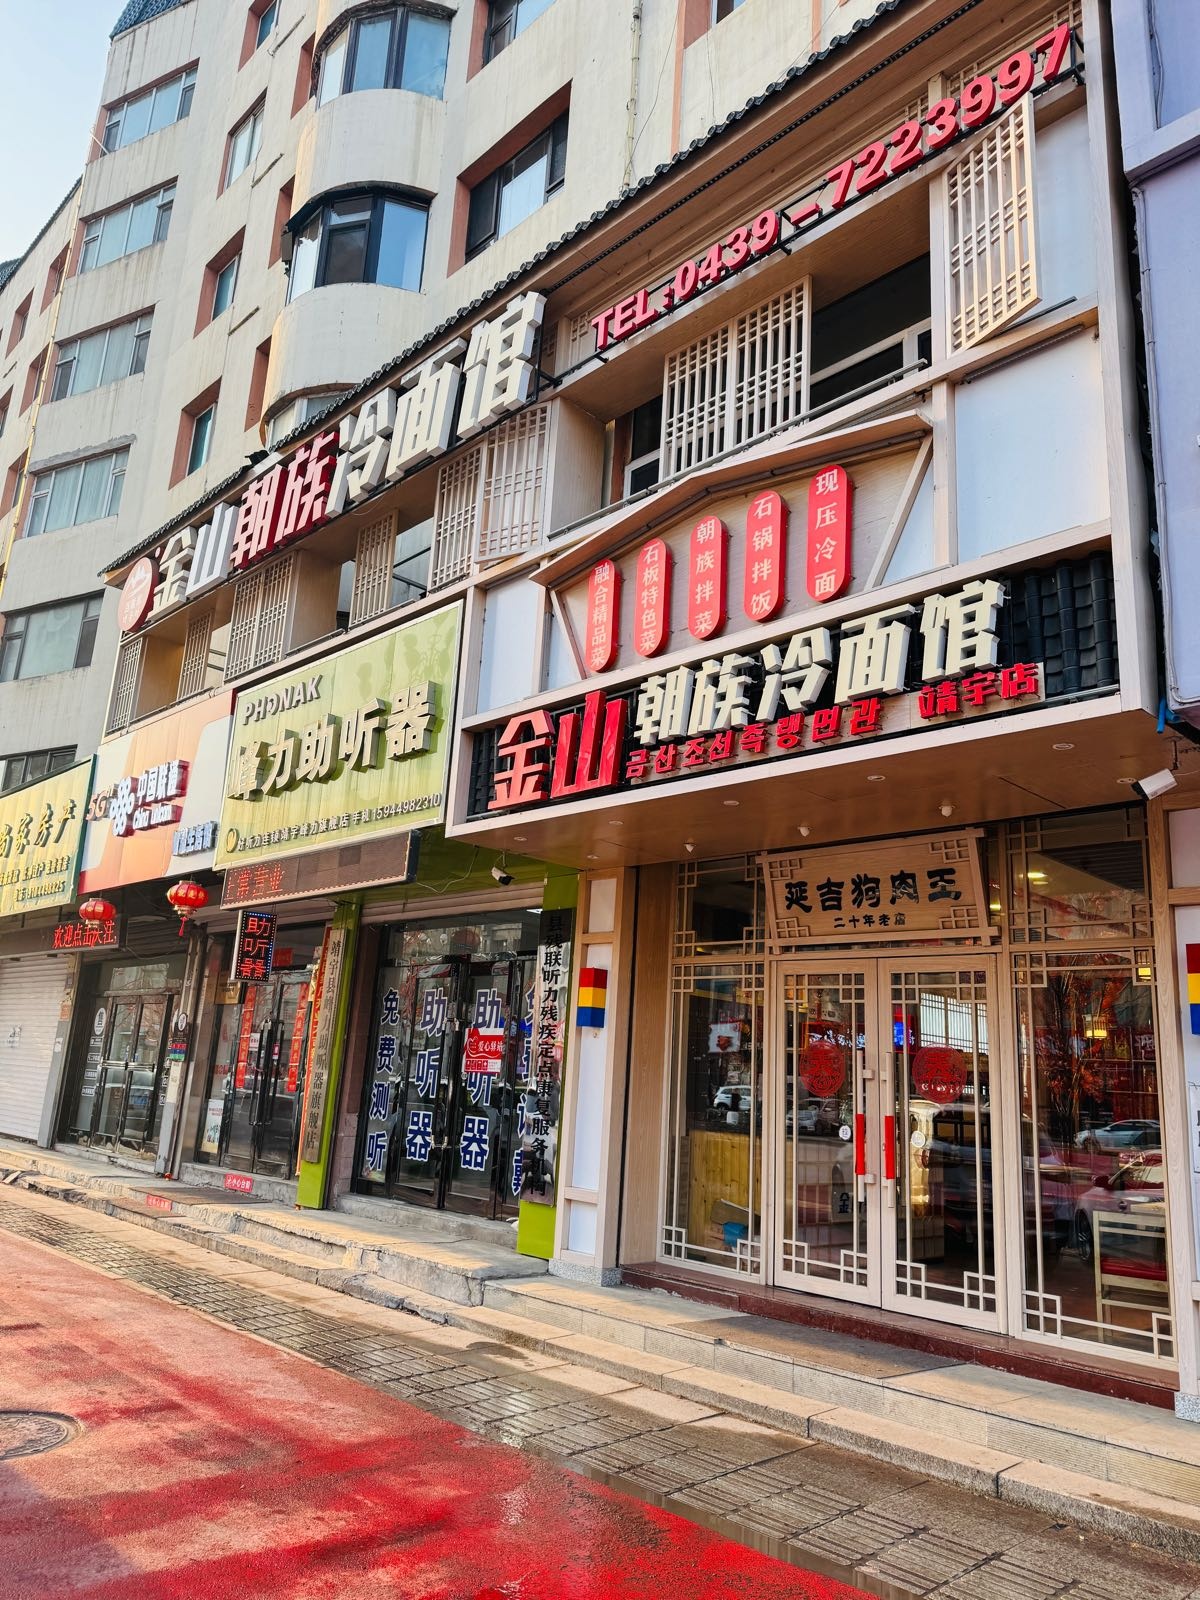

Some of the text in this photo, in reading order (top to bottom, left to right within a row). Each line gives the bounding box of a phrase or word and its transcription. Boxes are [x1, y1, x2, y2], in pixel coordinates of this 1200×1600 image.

[694, 521, 716, 635] 朝族拌菜
[749, 494, 773, 614] 石锅拌饭
[815, 468, 839, 598] 现压冷面
[589, 561, 611, 667] 融合精品菜
[640, 541, 660, 652] 石板特色菜
[227, 680, 441, 801] 峰力助听器
[242, 674, 323, 726] PHONAK
[487, 579, 1006, 810] 金山 朝族冷面馆
[919, 661, 1040, 720] 靖宇店
[137, 759, 187, 805] 中国联通
[352, 809, 370, 825] 手机
[372, 792, 441, 822] 15944982310
[785, 867, 962, 914] 延吉狗肉王
[833, 912, 906, 928] 二十年老店
[240, 916, 271, 978] 助听器
[304, 940, 342, 1151] 靖宇县峰力助听器旗舰店
[366, 987, 401, 1171] 免费测听
[405, 988, 447, 1162] 助听器
[460, 988, 503, 1172] 助听器
